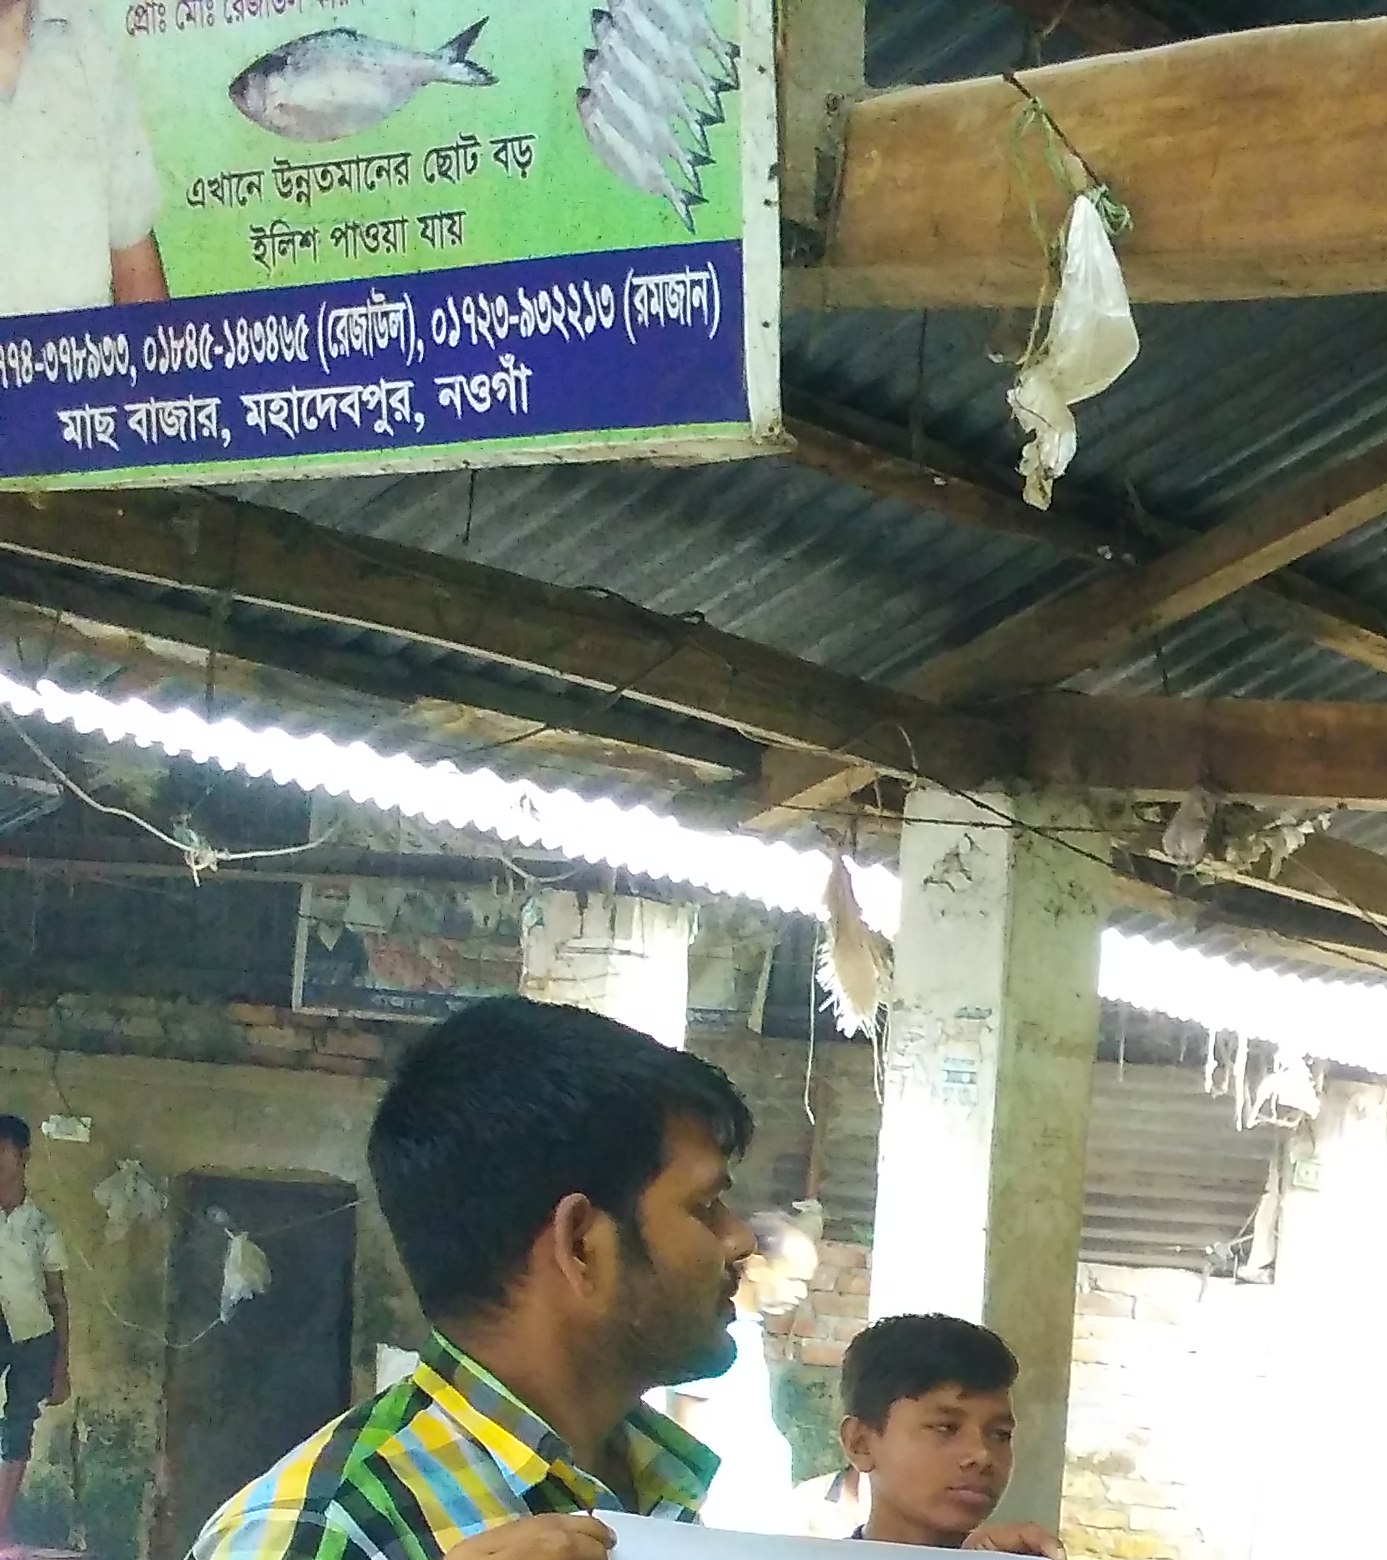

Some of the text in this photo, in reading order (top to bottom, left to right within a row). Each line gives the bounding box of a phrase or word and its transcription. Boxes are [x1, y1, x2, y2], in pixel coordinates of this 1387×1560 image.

[185, 132, 536, 209] এখানে উন্নতমানের ছোট বড়
[249, 209, 468, 277] ইলিশ পাওয়া যায়
[624, 261, 720, 344] (রমজান)
[58, 353, 533, 451] মাছ বাজার, মহাদেবপুর, নওগাঁ
